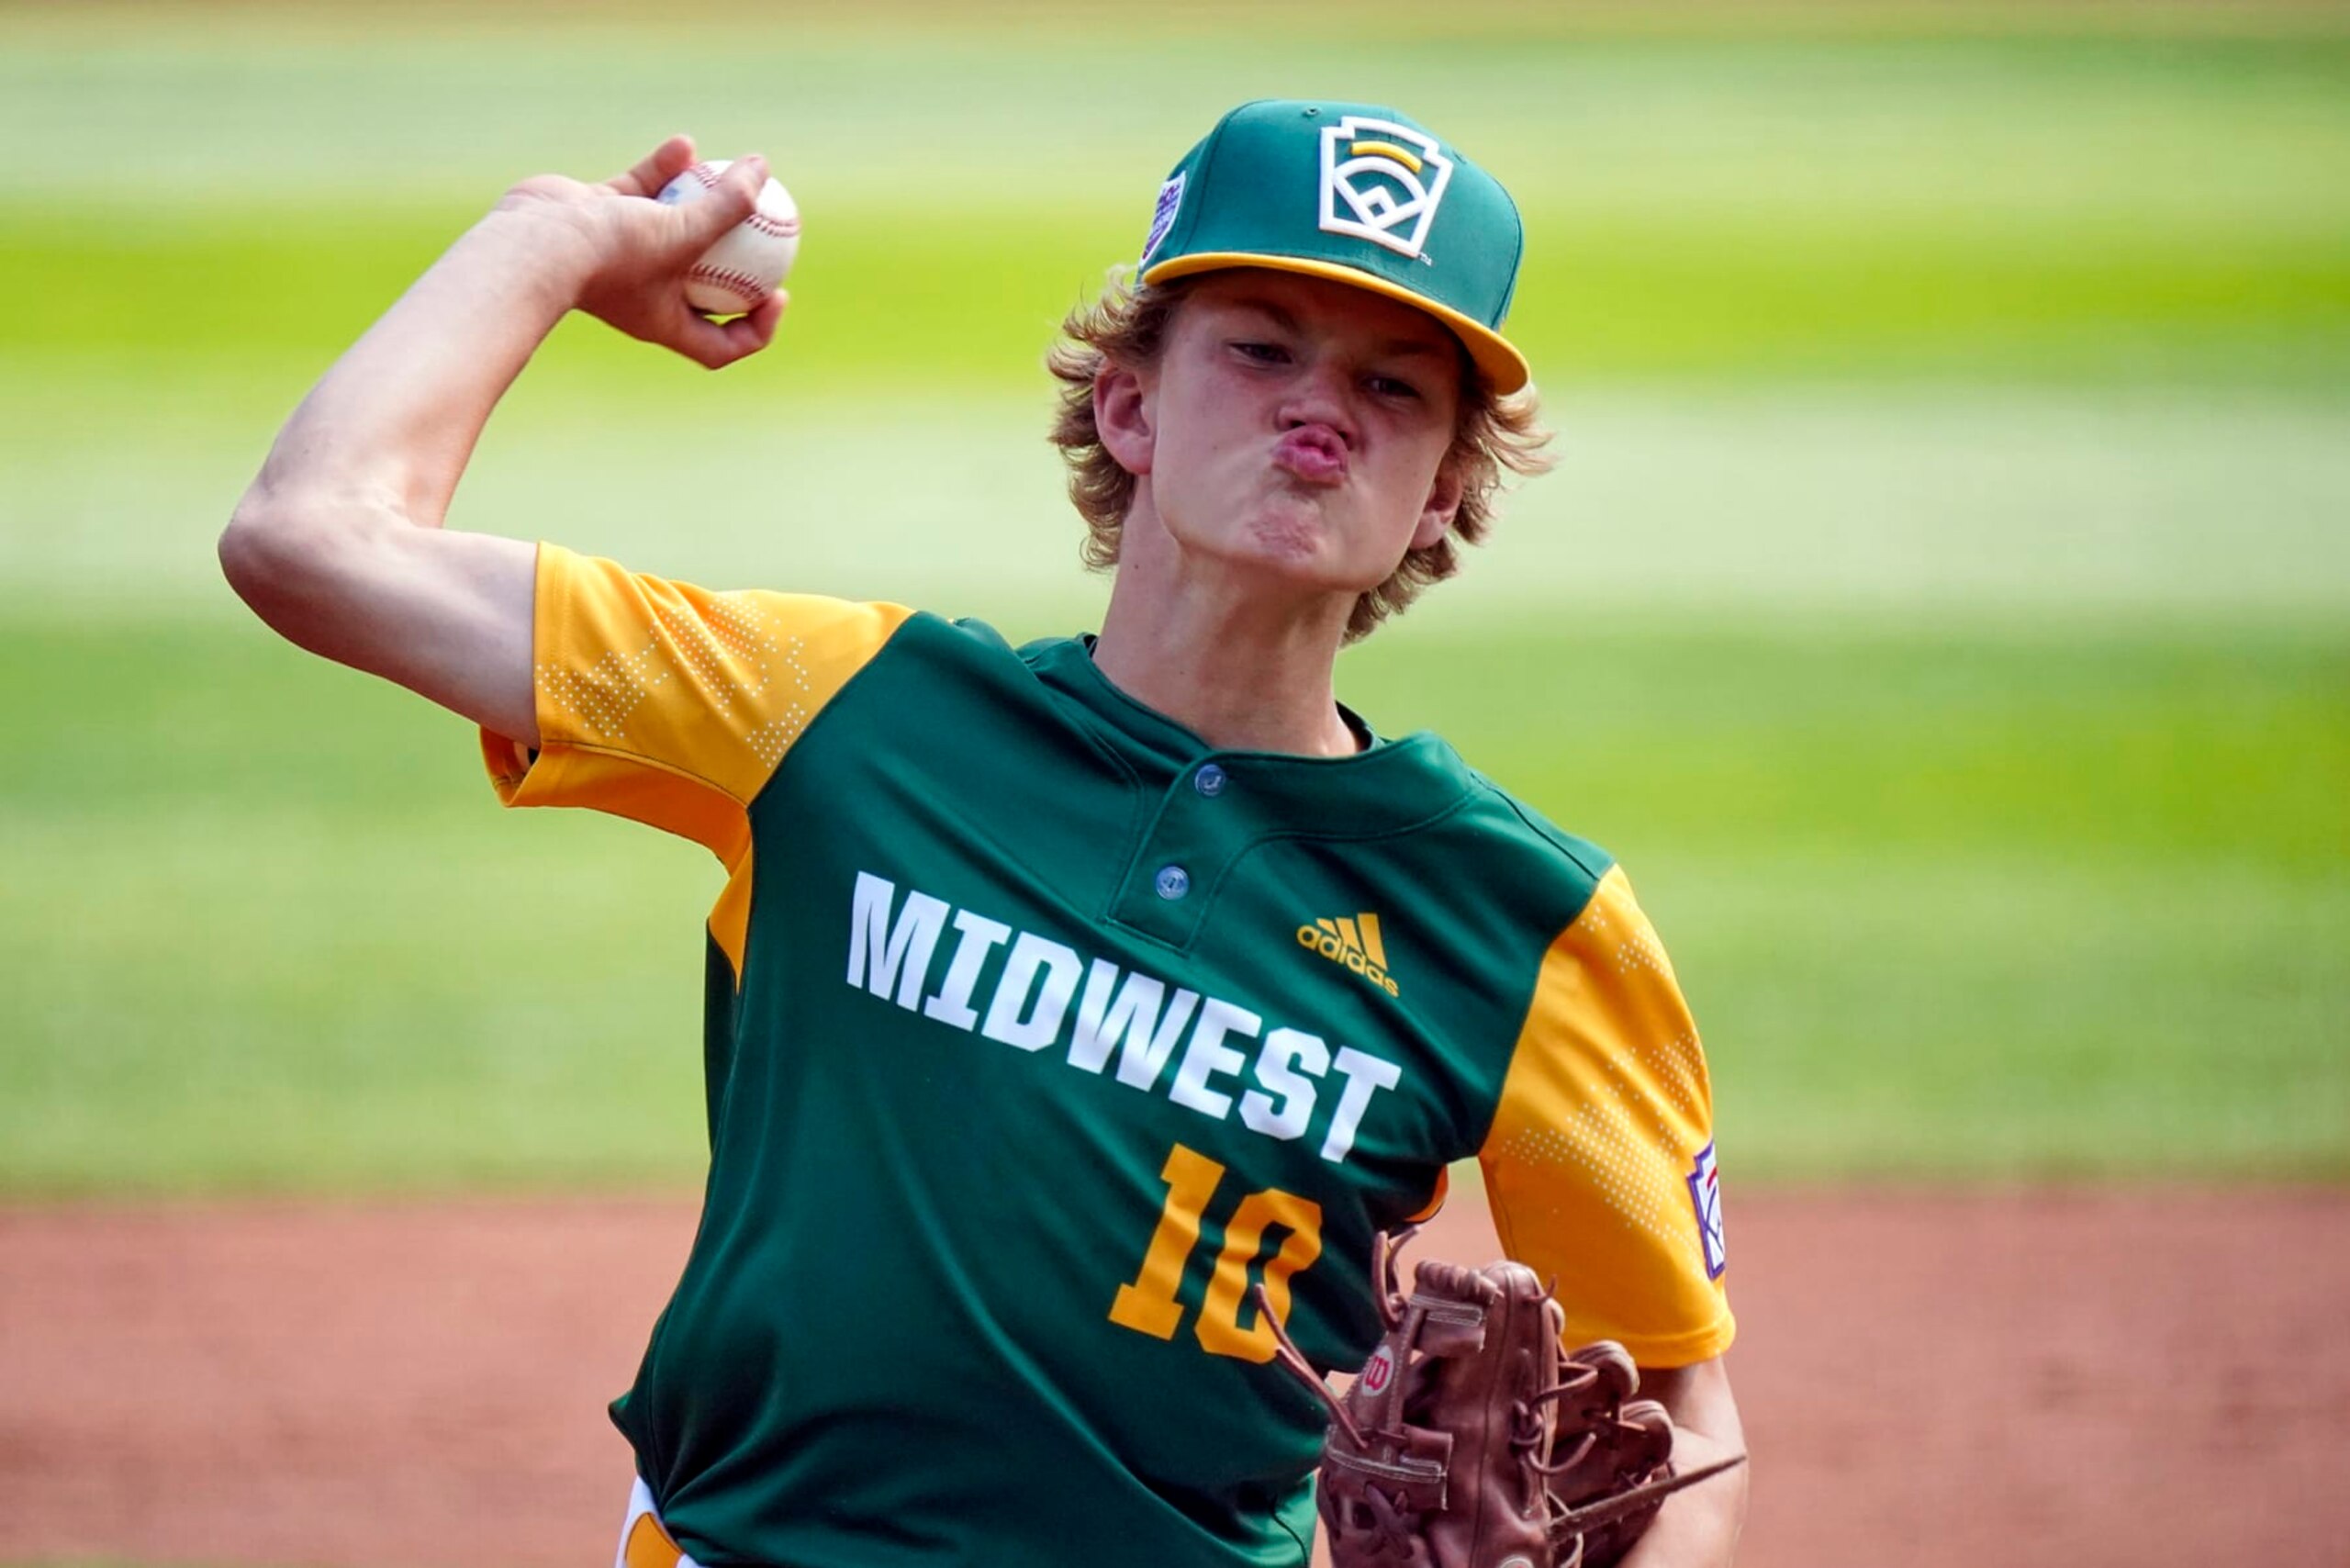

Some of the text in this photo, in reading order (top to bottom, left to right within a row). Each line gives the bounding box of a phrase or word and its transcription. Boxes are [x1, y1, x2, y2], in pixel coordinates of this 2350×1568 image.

[846, 870, 1402, 1163] MIDWEST
[1296, 924, 1400, 998] adidas
[1107, 1142, 1322, 1364] 10
